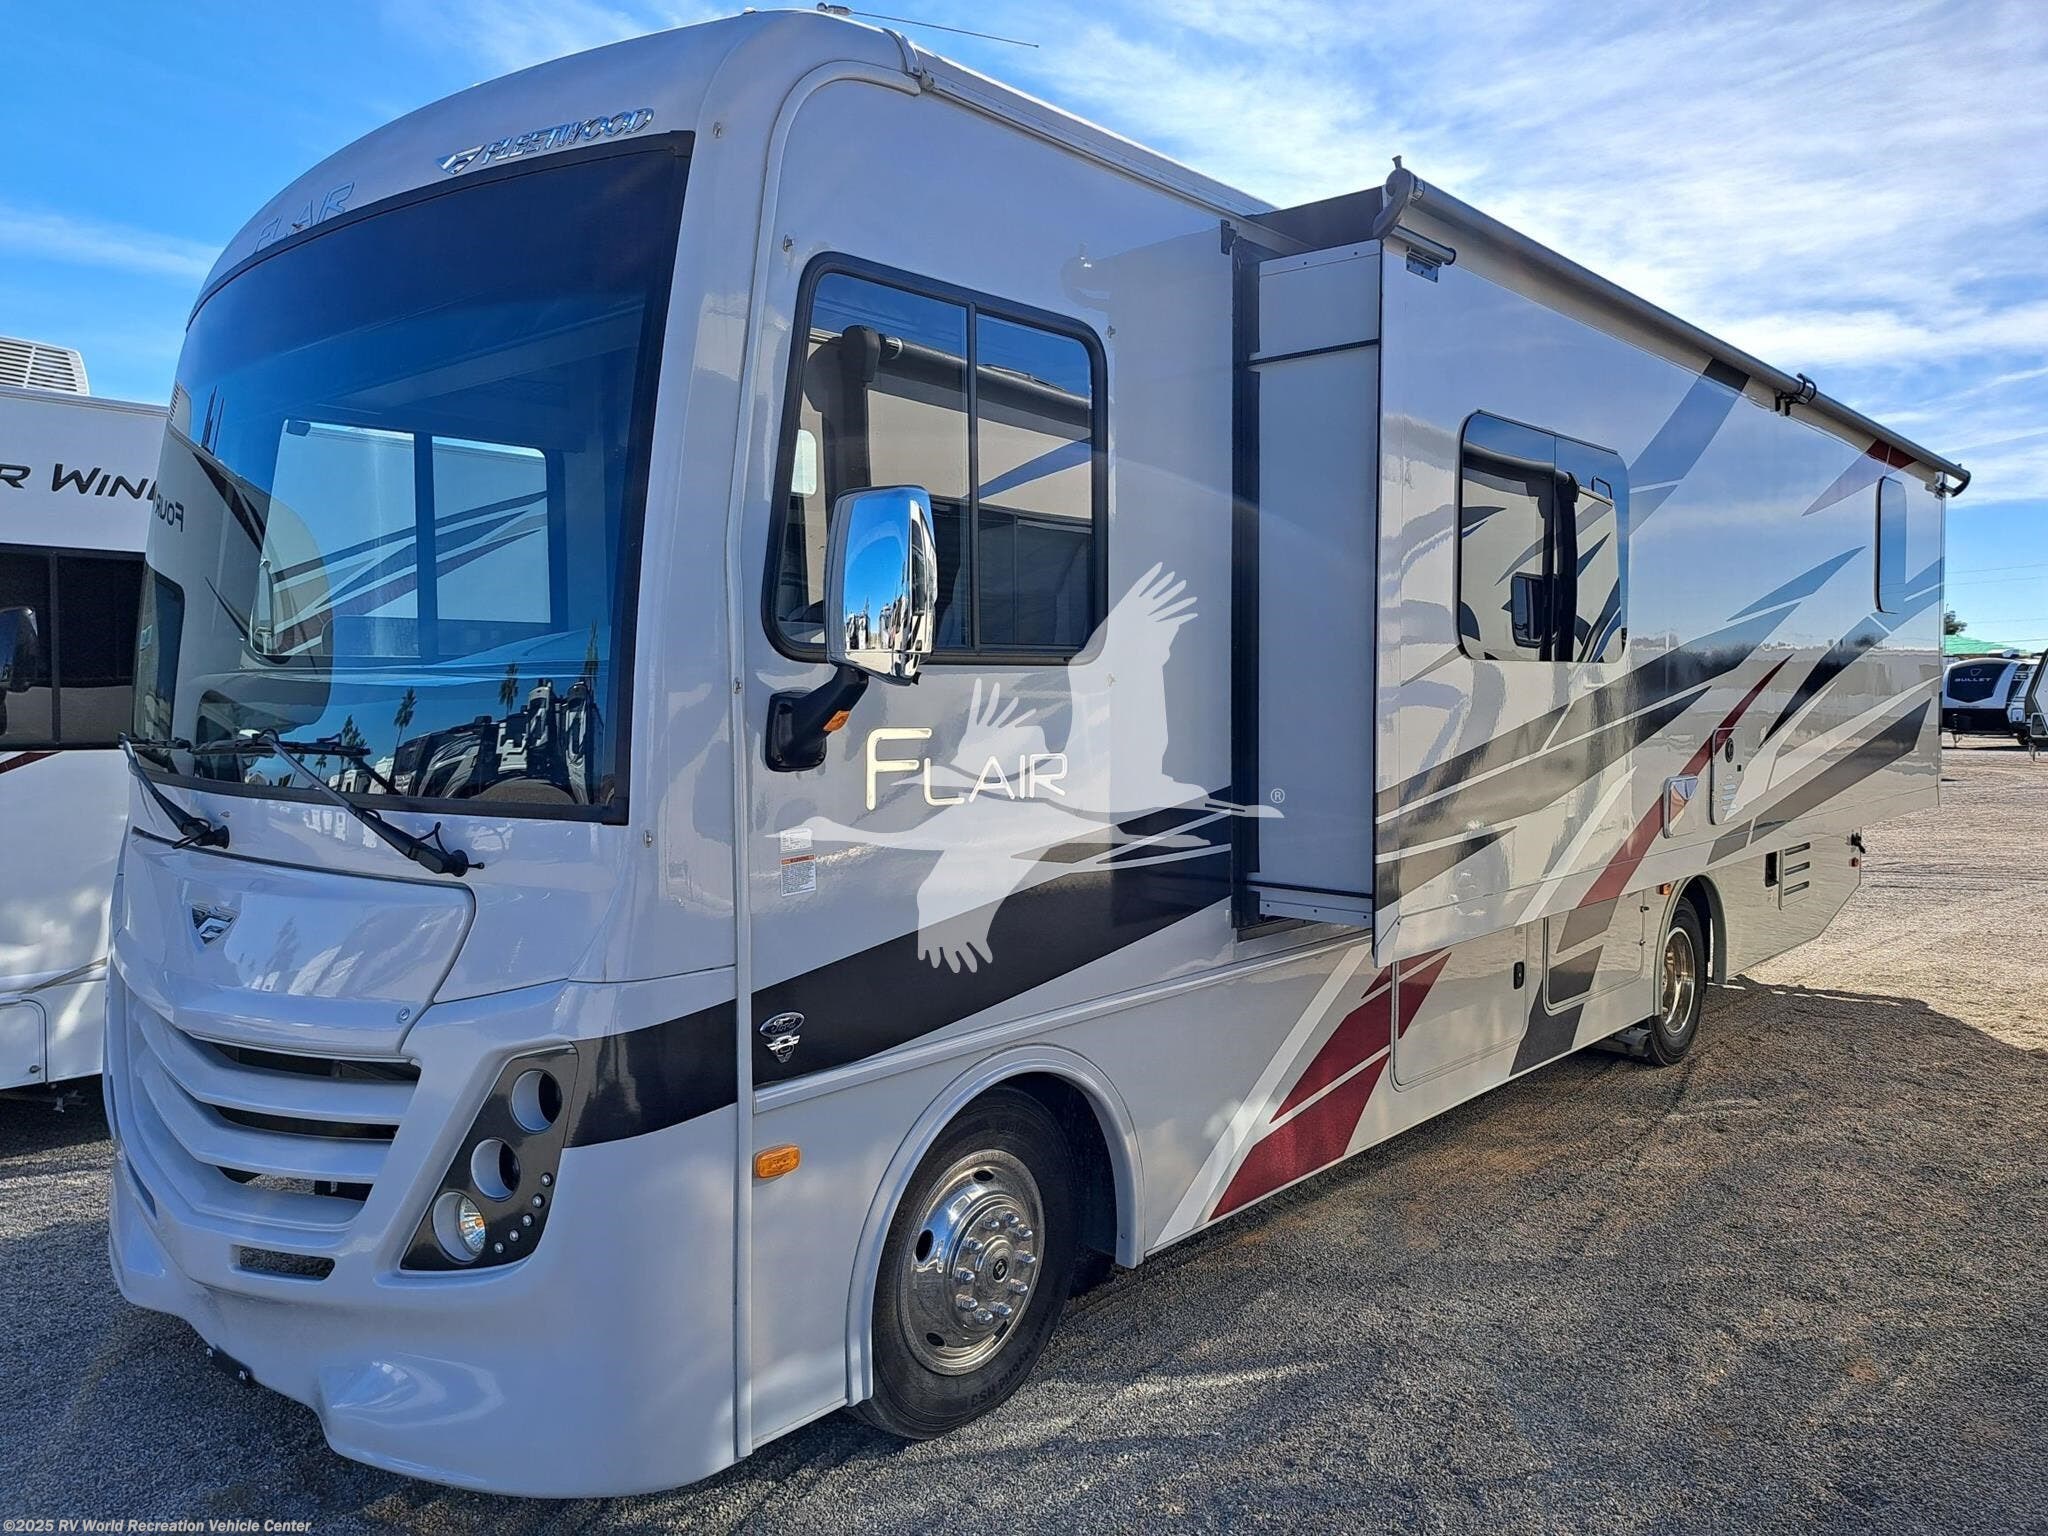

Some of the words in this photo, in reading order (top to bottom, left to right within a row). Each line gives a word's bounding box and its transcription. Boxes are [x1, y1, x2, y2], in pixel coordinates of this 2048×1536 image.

[481, 107, 655, 165] FLEETWOOD
[51, 463, 156, 500] WIN
[866, 727, 1068, 811] FLAIR
